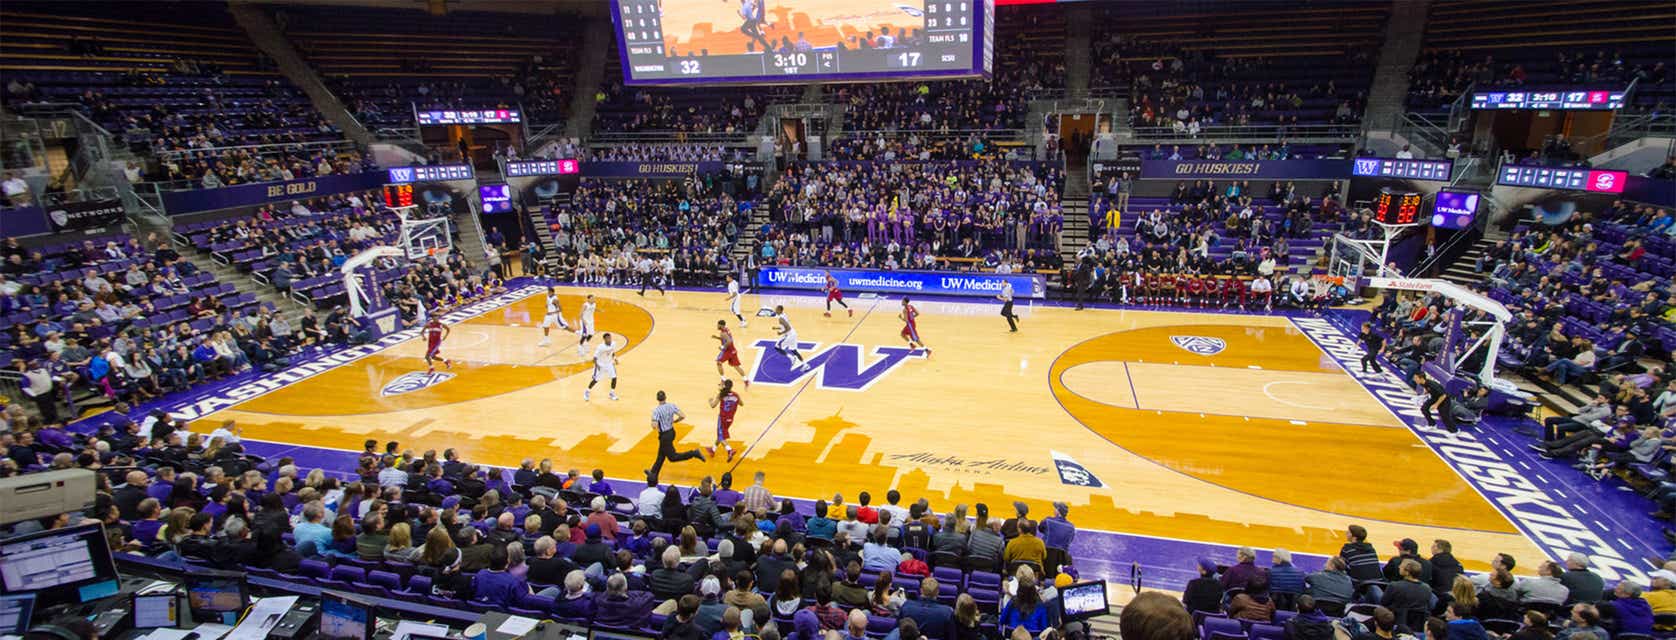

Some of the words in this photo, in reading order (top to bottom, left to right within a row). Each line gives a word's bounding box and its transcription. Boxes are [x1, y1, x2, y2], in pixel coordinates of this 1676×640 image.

[680, 60, 700, 74] 32
[774, 53, 807, 67] 3:10
[899, 52, 920, 67] 17
[1507, 93, 1523, 102] 32
[1567, 93, 1586, 102] 17
[639, 163, 652, 173] GO
[1175, 163, 1194, 175] GO
[267, 185, 285, 198] BE
[287, 182, 317, 196] GOLD
[68, 206, 124, 219] NETWORKS
[768, 271, 788, 282] UW
[787, 272, 827, 284] Medicin
[848, 277, 923, 290] uwmedicine.org
[941, 277, 963, 289] UW
[437, 284, 549, 328] HUSKIES
[748, 338, 928, 392] W
[889, 452, 962, 467] Alaska
[967, 459, 1051, 475] Airlines
[1412, 424, 1651, 587] HUSKIES
